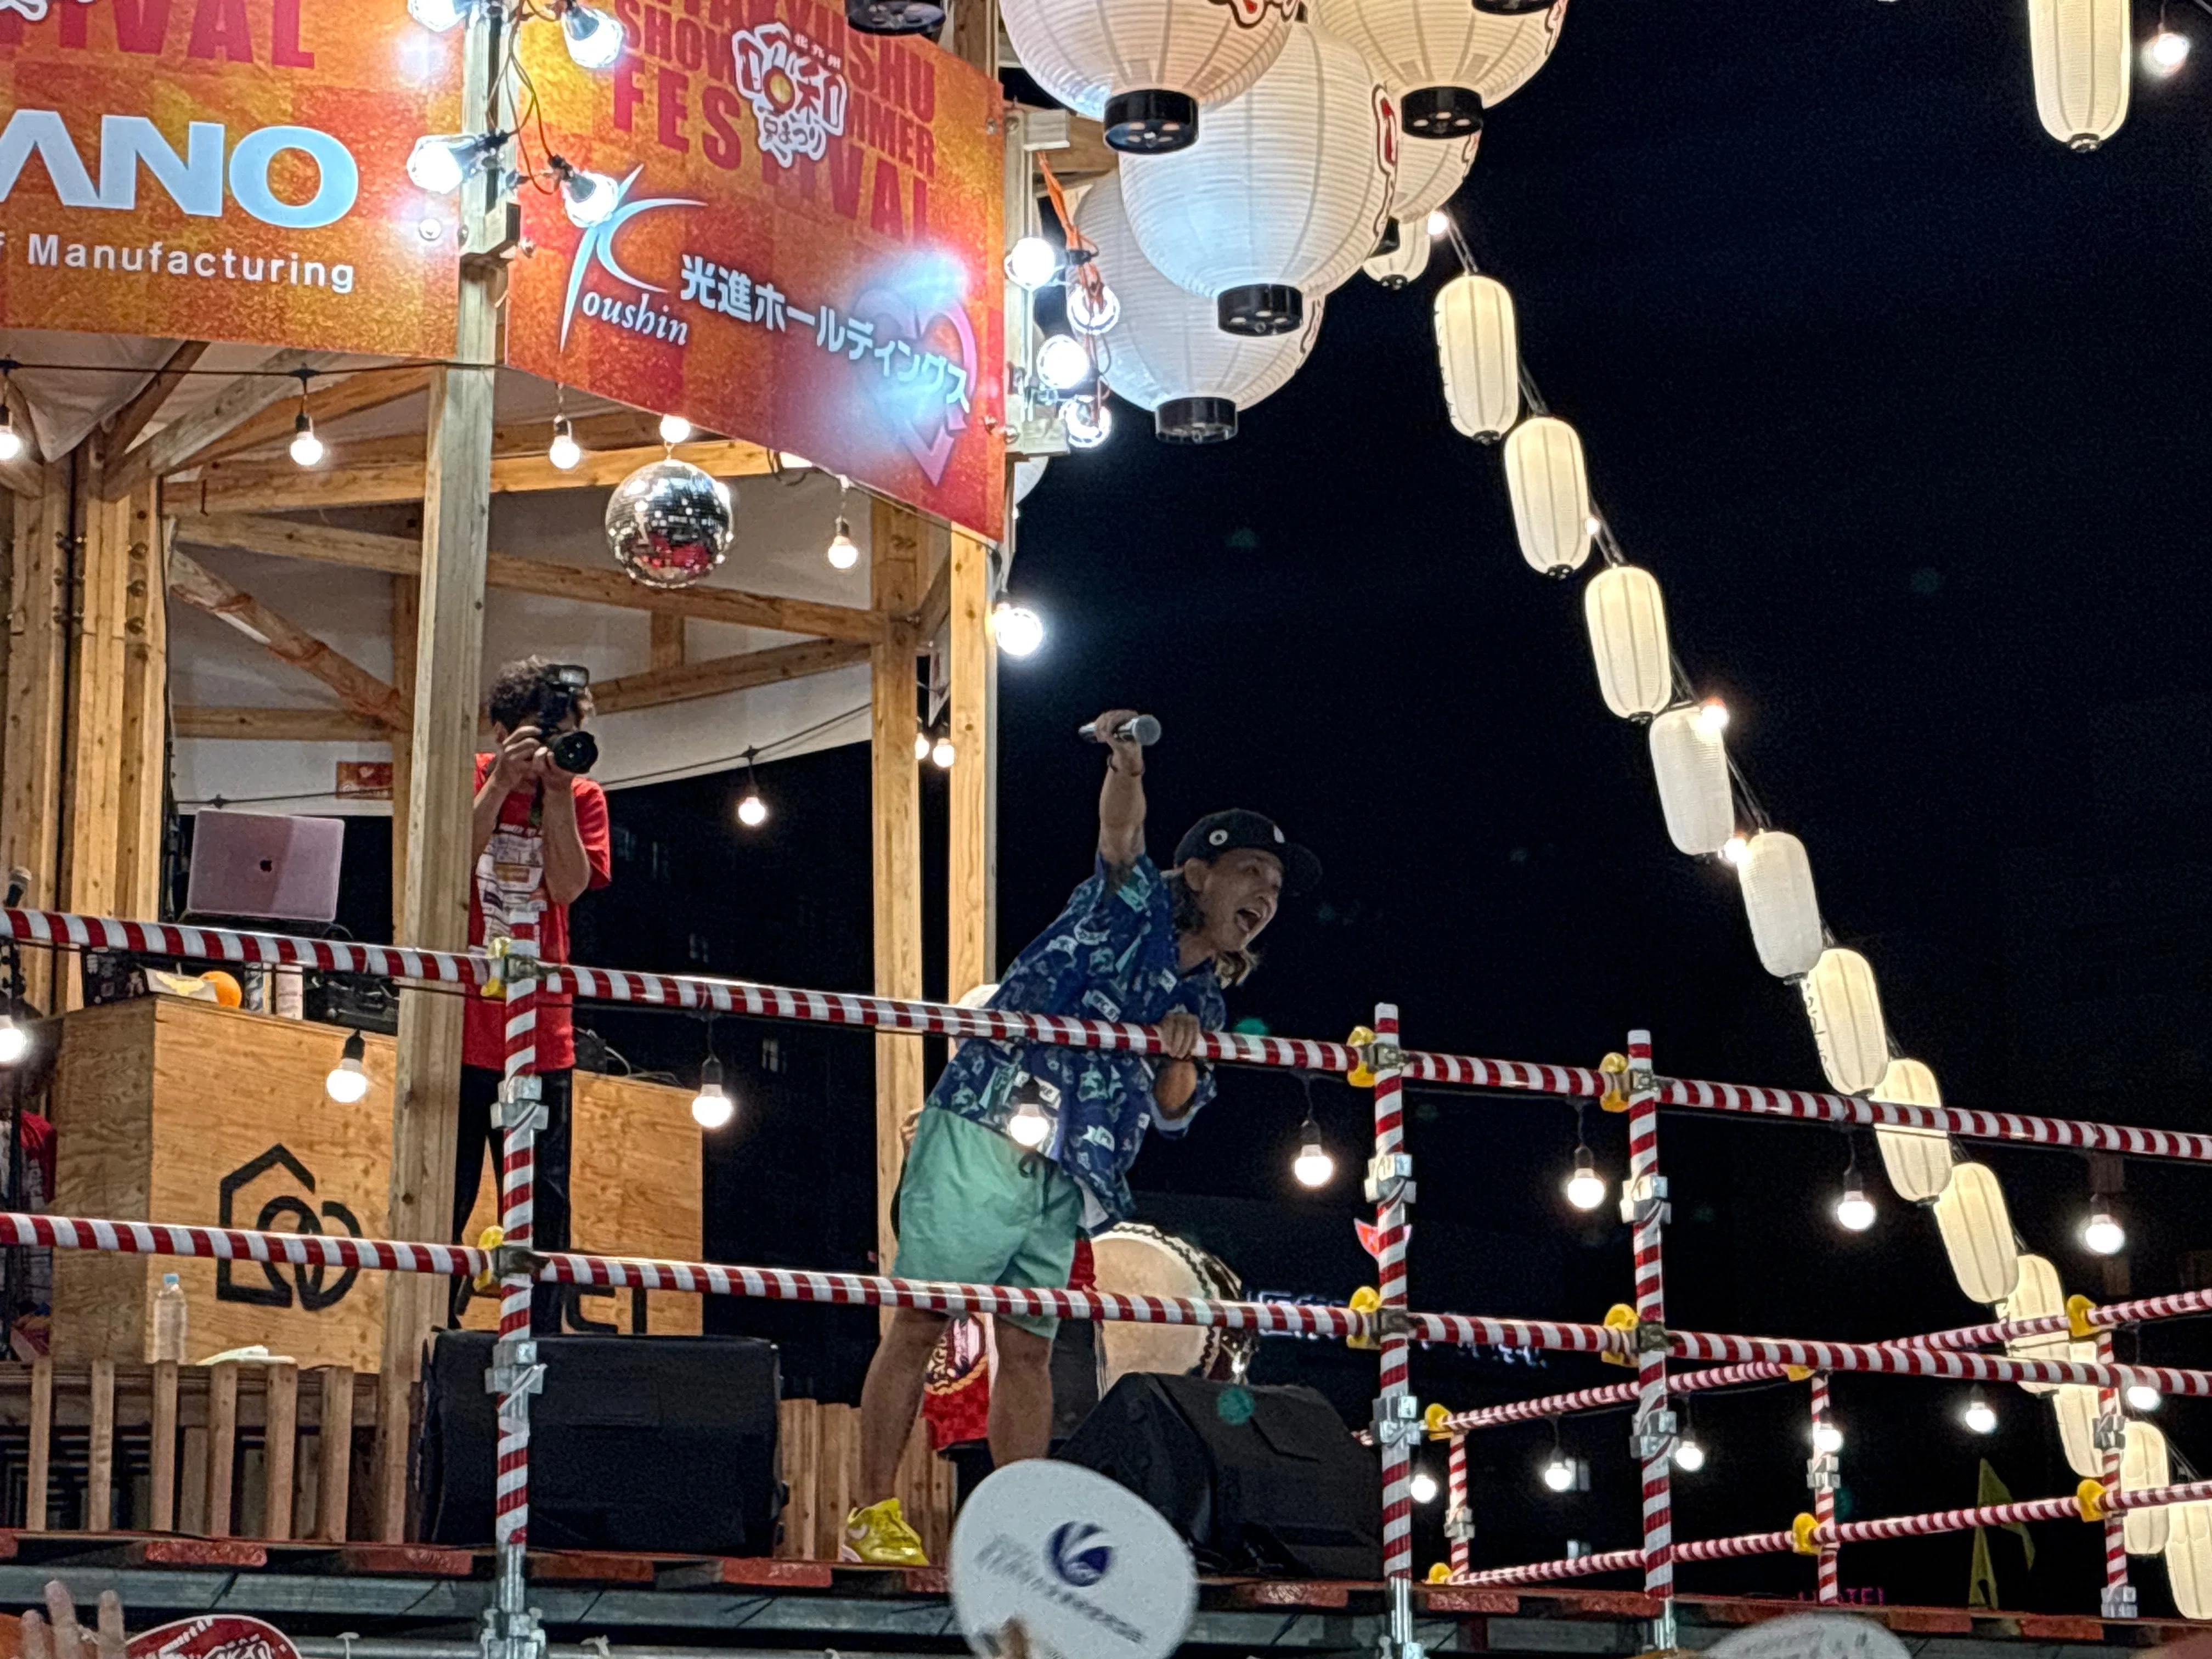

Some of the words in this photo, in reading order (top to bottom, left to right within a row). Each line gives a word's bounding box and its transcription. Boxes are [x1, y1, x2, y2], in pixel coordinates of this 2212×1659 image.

[29, 233, 354, 294] Manufacturing
[680, 253, 970, 413] 光進ホールディングス
